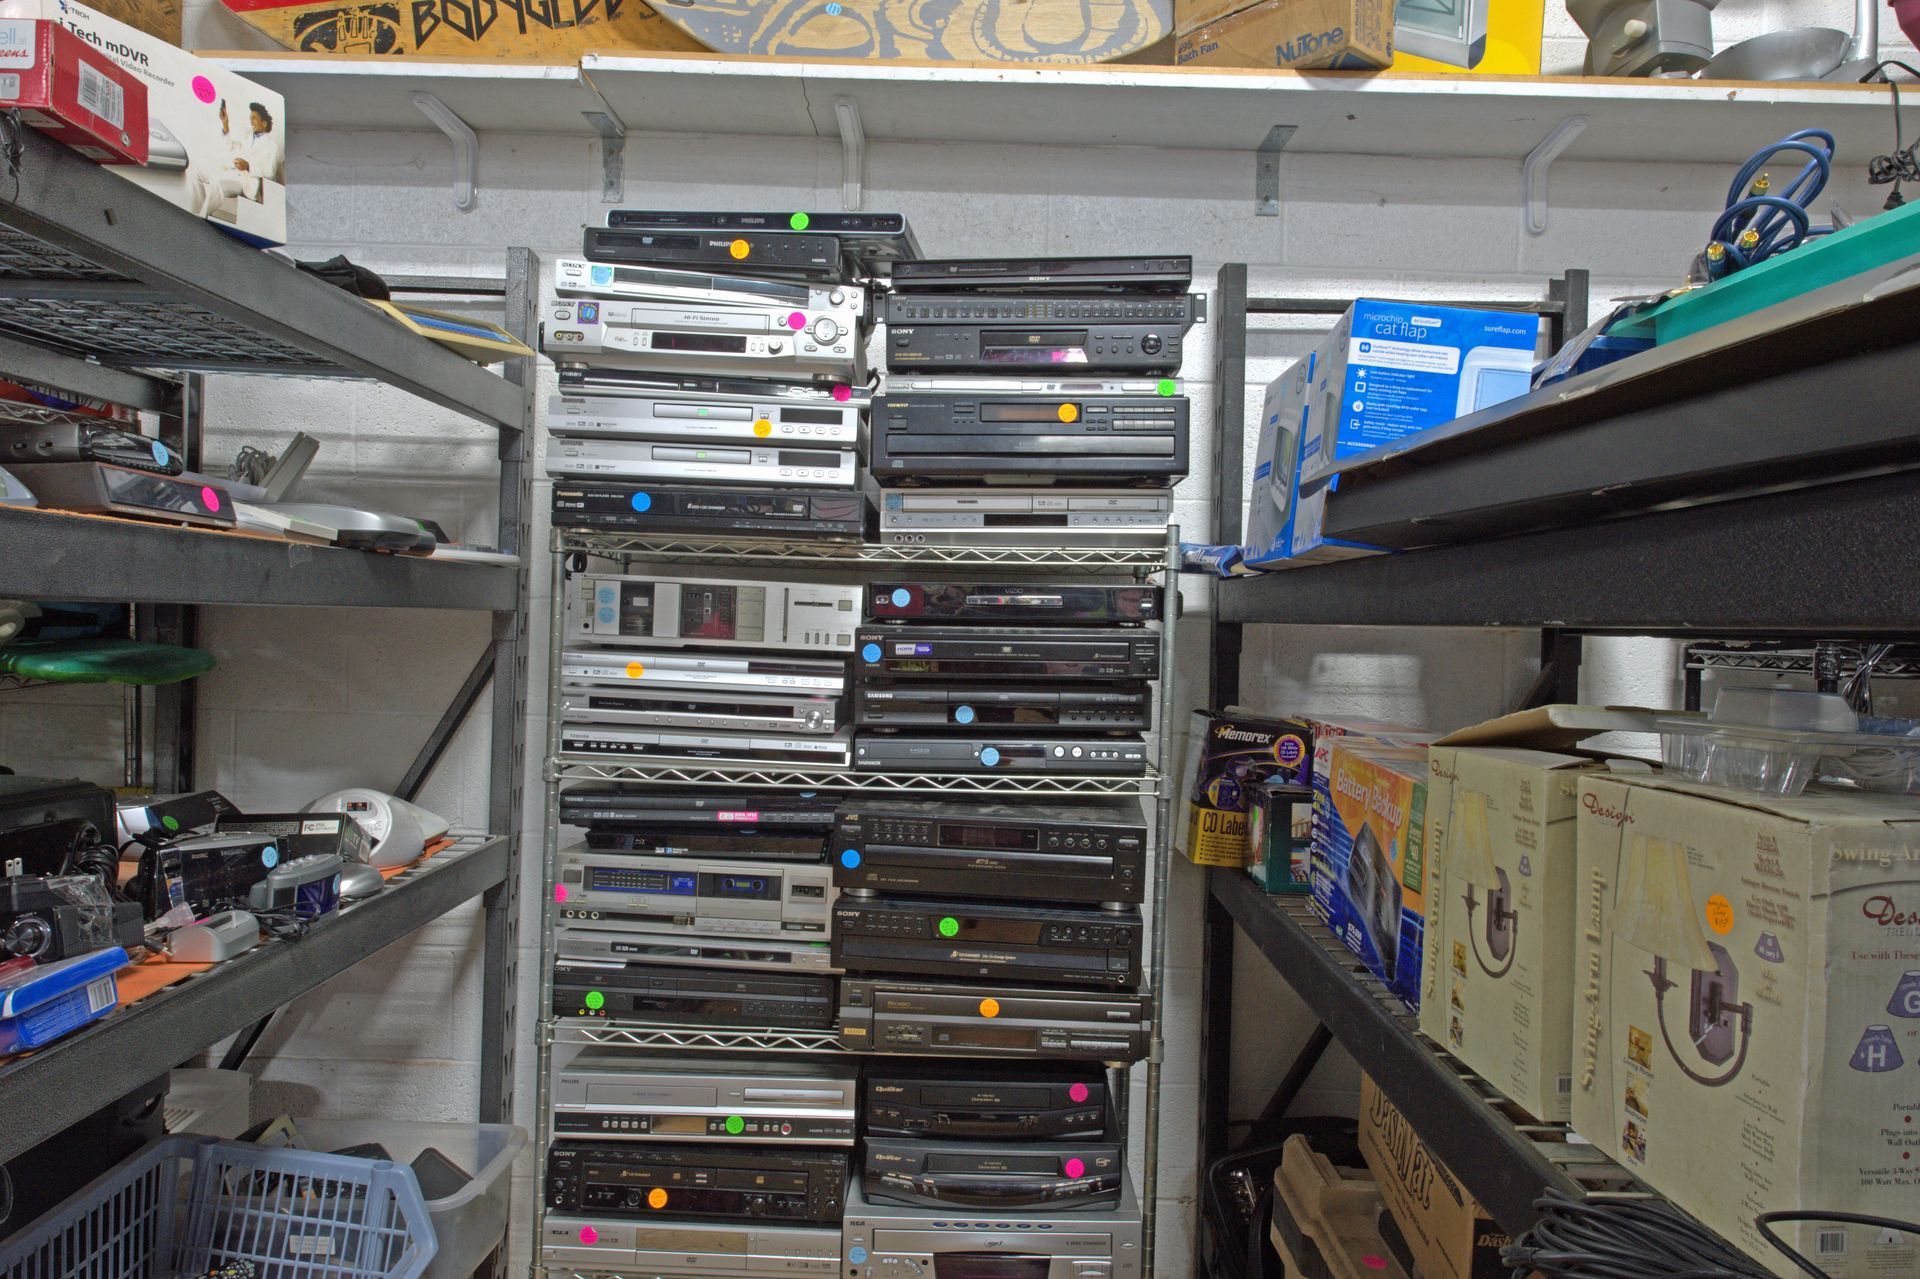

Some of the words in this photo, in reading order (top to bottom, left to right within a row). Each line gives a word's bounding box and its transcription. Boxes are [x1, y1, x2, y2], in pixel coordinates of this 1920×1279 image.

[68, 21, 102, 46] Tech
[106, 39, 150, 67] mDVR
[1178, 49, 1199, 64] Bath
[1200, 42, 1219, 55] Fan
[1275, 26, 1345, 66] NuTone
[120, 57, 142, 75] Video
[143, 69, 175, 87] Recorder
[1363, 313, 1404, 325] microchip
[1484, 324, 1527, 336] sureflap.com
[1375, 322, 1398, 336] cat
[1399, 321, 1427, 342] flap
[1217, 727, 1272, 747] Memorex
[1431, 759, 1459, 784] Design
[1337, 768, 1371, 813] Battery
[1371, 785, 1403, 830] Backup
[1582, 792, 1635, 828] Design
[1203, 812, 1218, 833] CD
[1431, 818, 1443, 880] Lamp
[1584, 867, 1607, 944] Lamp
[1425, 883, 1440, 999] Swing-Arm
[1852, 951, 1870, 960] Use
[1870, 951, 1890, 960] with
[1893, 950, 1920, 960] These
[1904, 990, 1920, 1014] G
[1579, 948, 1602, 1090] Swing-Arm
[1867, 1045, 1886, 1067] H
[1622, 1056, 1639, 1072] Living
[1639, 1064, 1655, 1080] Room
[1623, 1105, 1648, 1124] Bedroom
[1881, 1128, 1902, 1138] Plugs
[1887, 1138, 1903, 1146] Wall
[1627, 1155, 1638, 1168] Den
[1859, 1167, 1890, 1175] Versatile
[1892, 1167, 1913, 1176] 3-Way
[1861, 1178, 1873, 1186] 100
[1875, 1178, 1892, 1186] Watt
[1894, 1178, 1912, 1186] Max.
[1477, 1235, 1513, 1249] Dash
